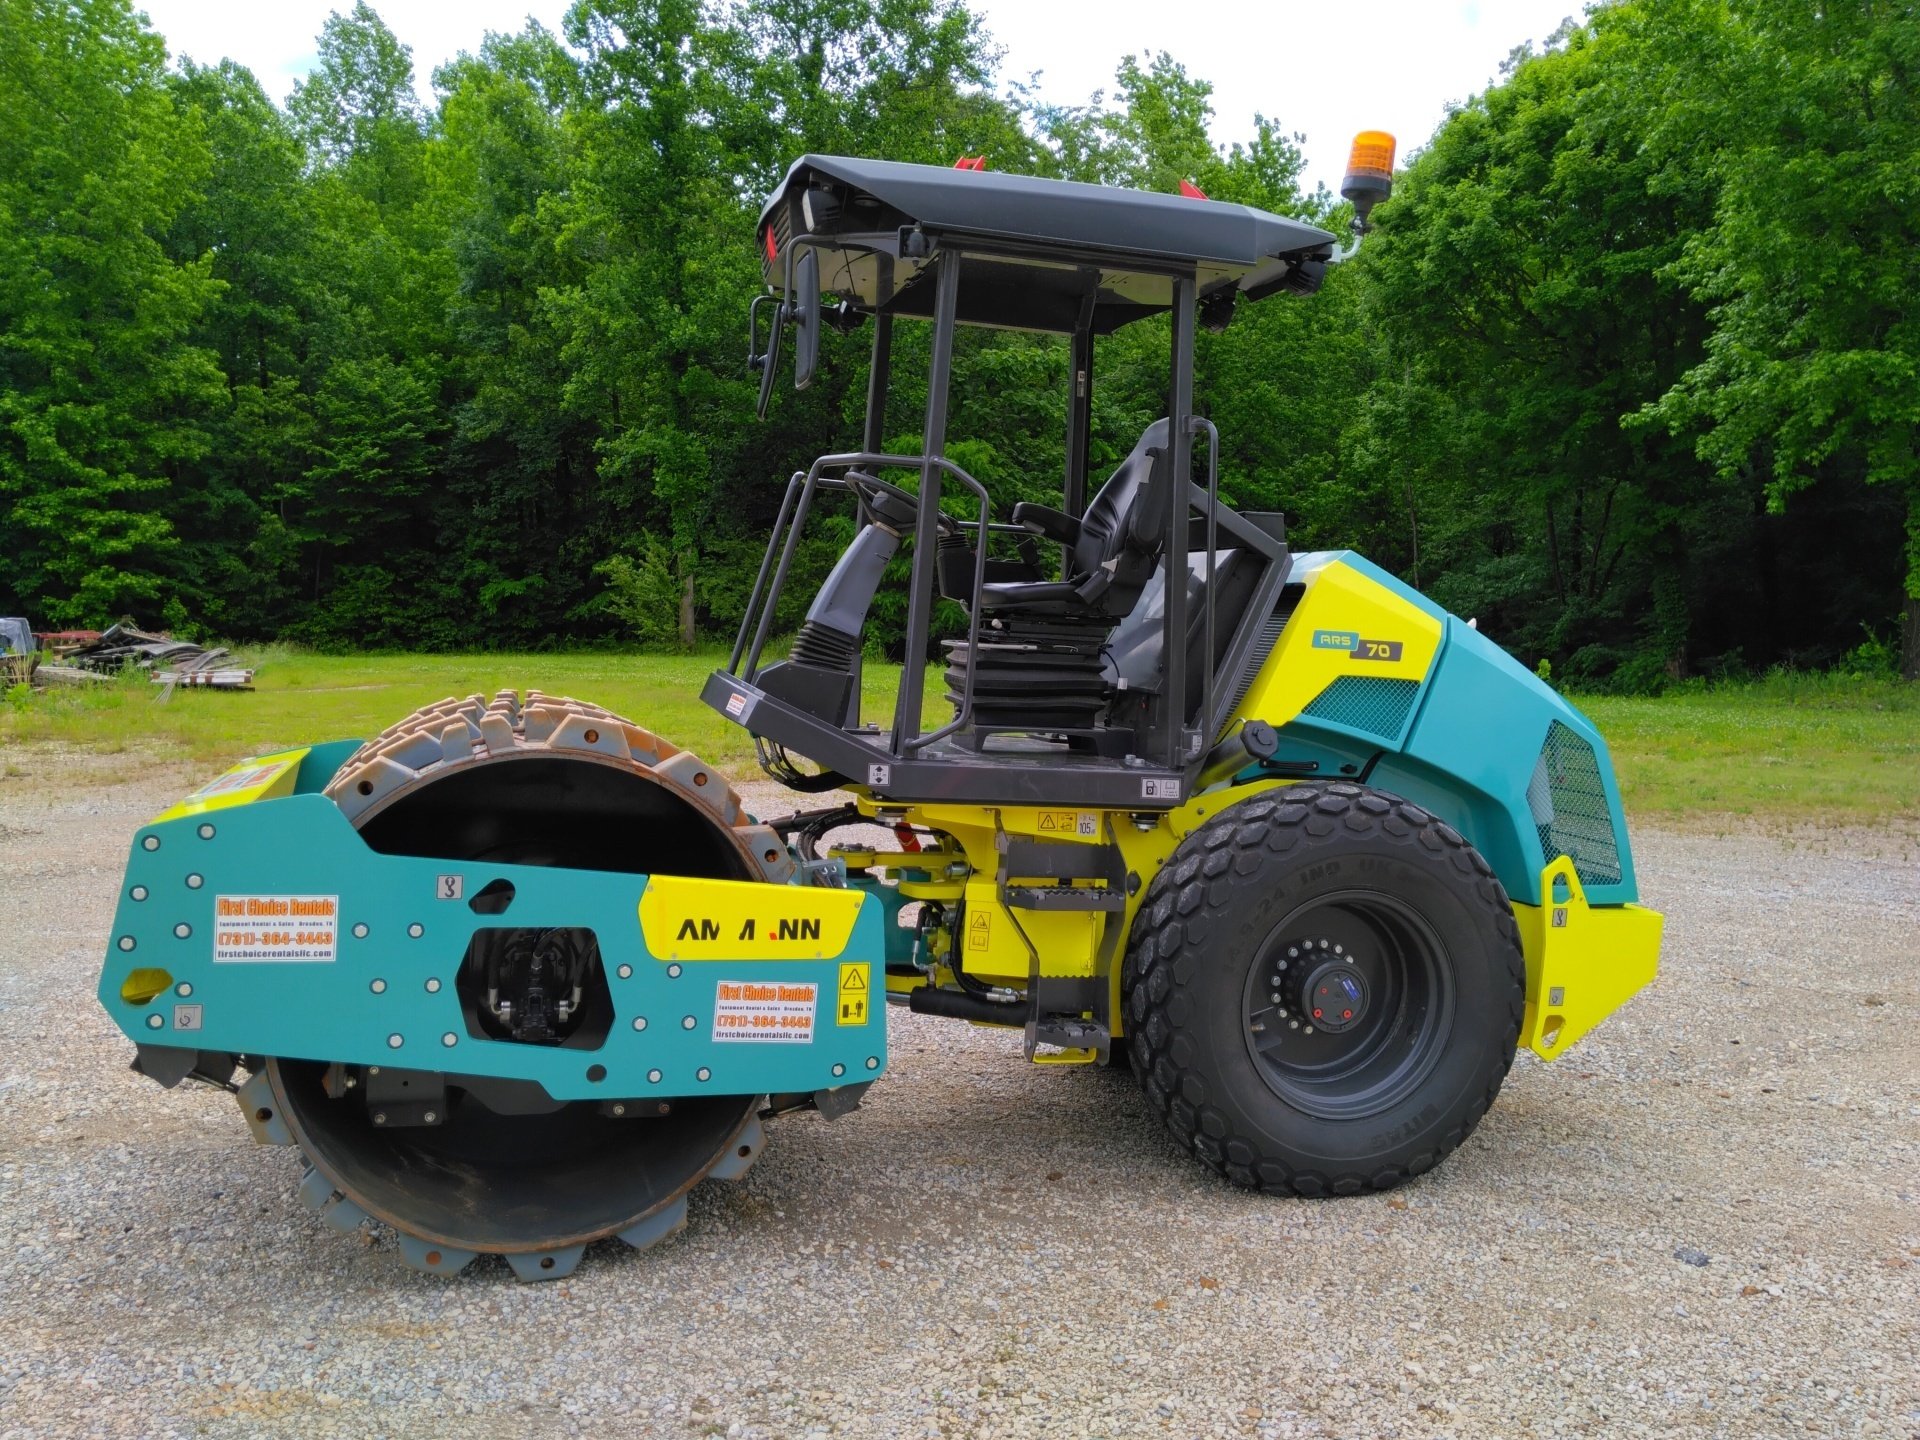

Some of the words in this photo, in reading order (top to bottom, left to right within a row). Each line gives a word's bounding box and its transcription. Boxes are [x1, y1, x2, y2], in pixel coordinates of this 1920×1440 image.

[1320, 634, 1351, 646] ARS
[1366, 643, 1391, 658] 70
[1080, 822, 1091, 834] 105
[218, 898, 246, 917] First
[246, 898, 288, 917] Choice
[289, 898, 335, 917] Rentals
[218, 931, 333, 946] (731)-364-3443
[217, 949, 332, 958] firstchoicerentalsllc.com
[718, 984, 743, 1001] First
[742, 984, 777, 1002] Choice
[777, 985, 814, 1003] Rentals
[717, 1014, 811, 1029] (731)-364-3443
